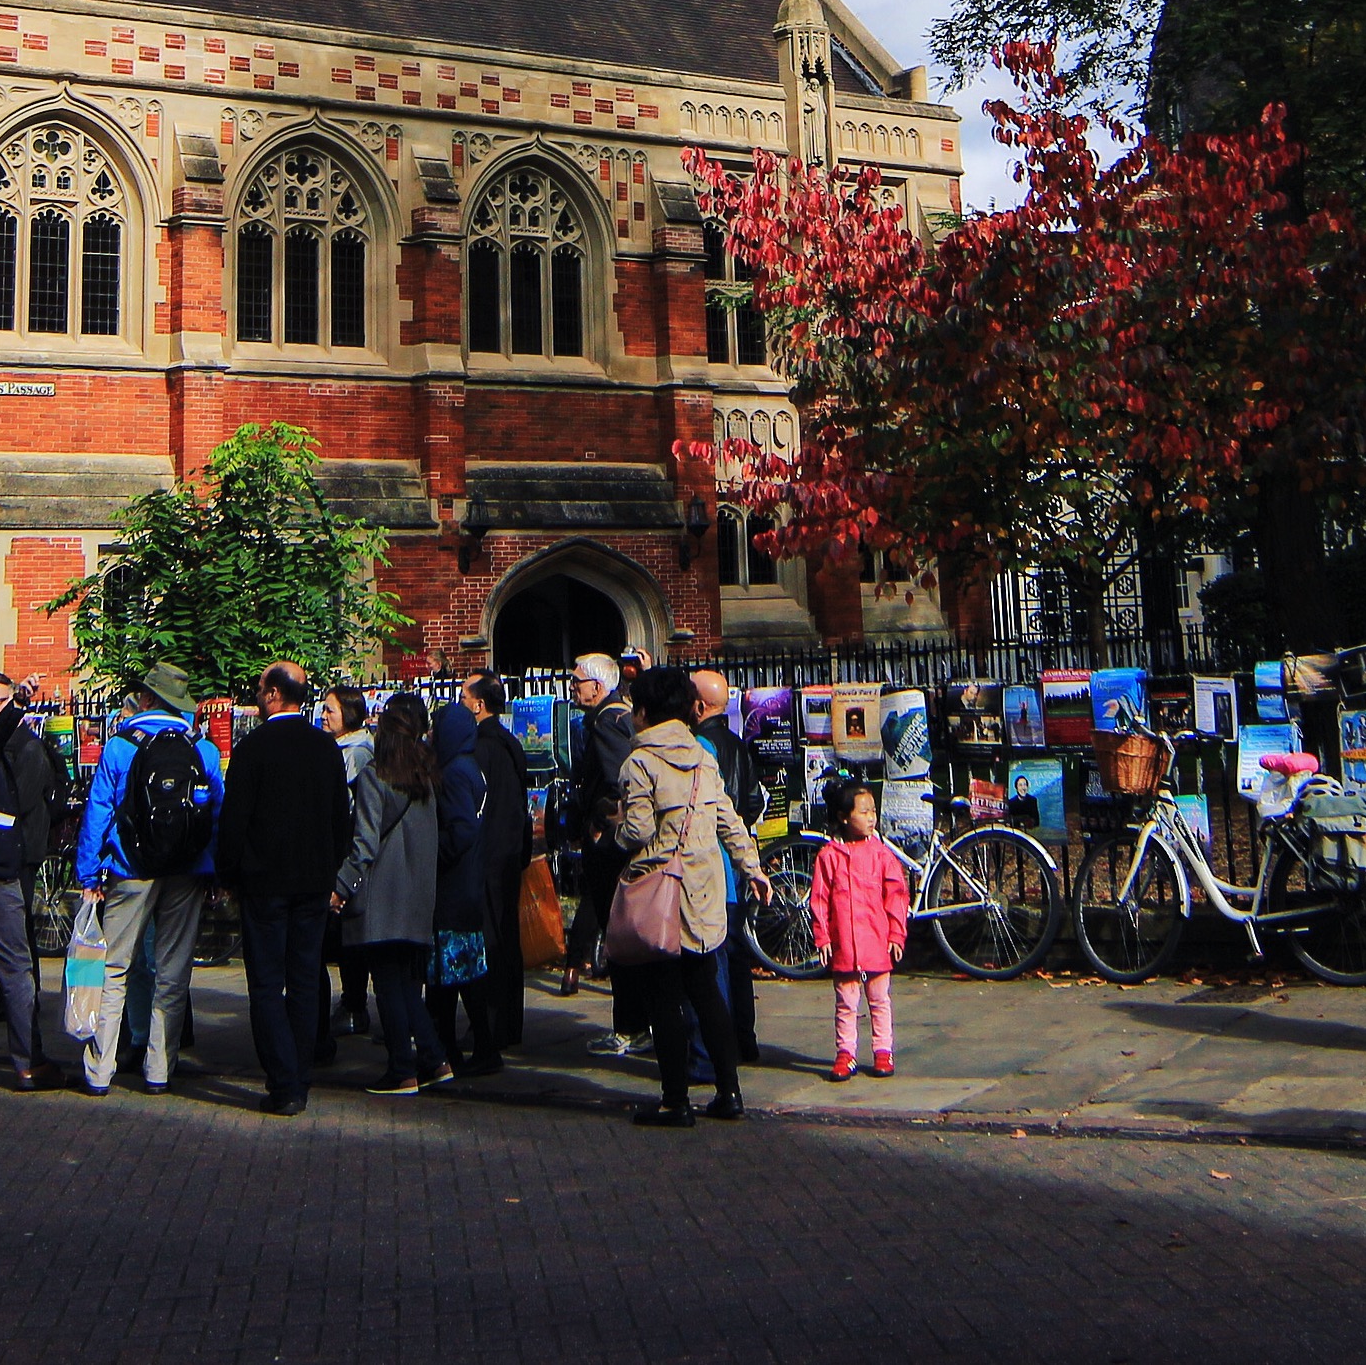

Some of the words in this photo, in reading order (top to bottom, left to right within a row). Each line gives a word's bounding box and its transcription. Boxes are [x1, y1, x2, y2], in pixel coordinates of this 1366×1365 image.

[8, 382, 53, 395] PASSAGE
[201, 702, 230, 714] GYPSY
[892, 712, 924, 761] CAMBRIDGE
[903, 722, 928, 761] FESTIVAL
